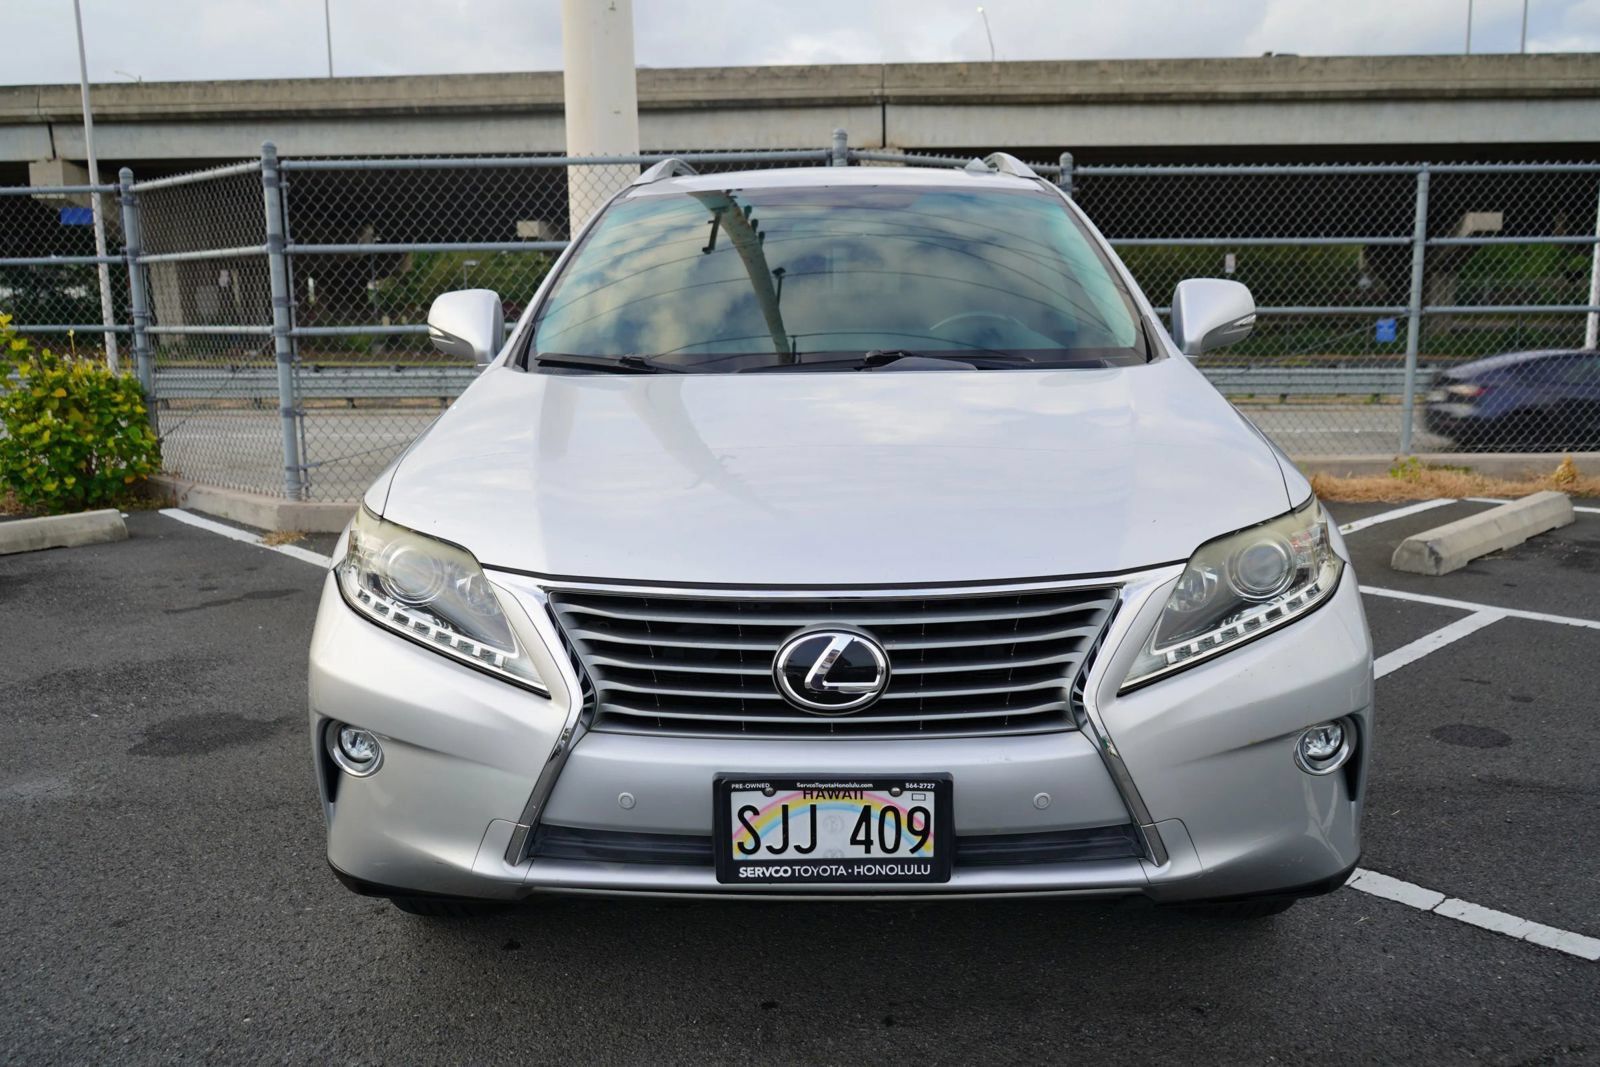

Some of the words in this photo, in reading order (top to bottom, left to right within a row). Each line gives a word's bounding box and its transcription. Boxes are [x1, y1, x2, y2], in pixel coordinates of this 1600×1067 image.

[803, 789, 864, 800] HAWAII
[737, 804, 817, 855] SJJ
[849, 804, 931, 855] 409
[739, 866, 792, 878] SERVCO
